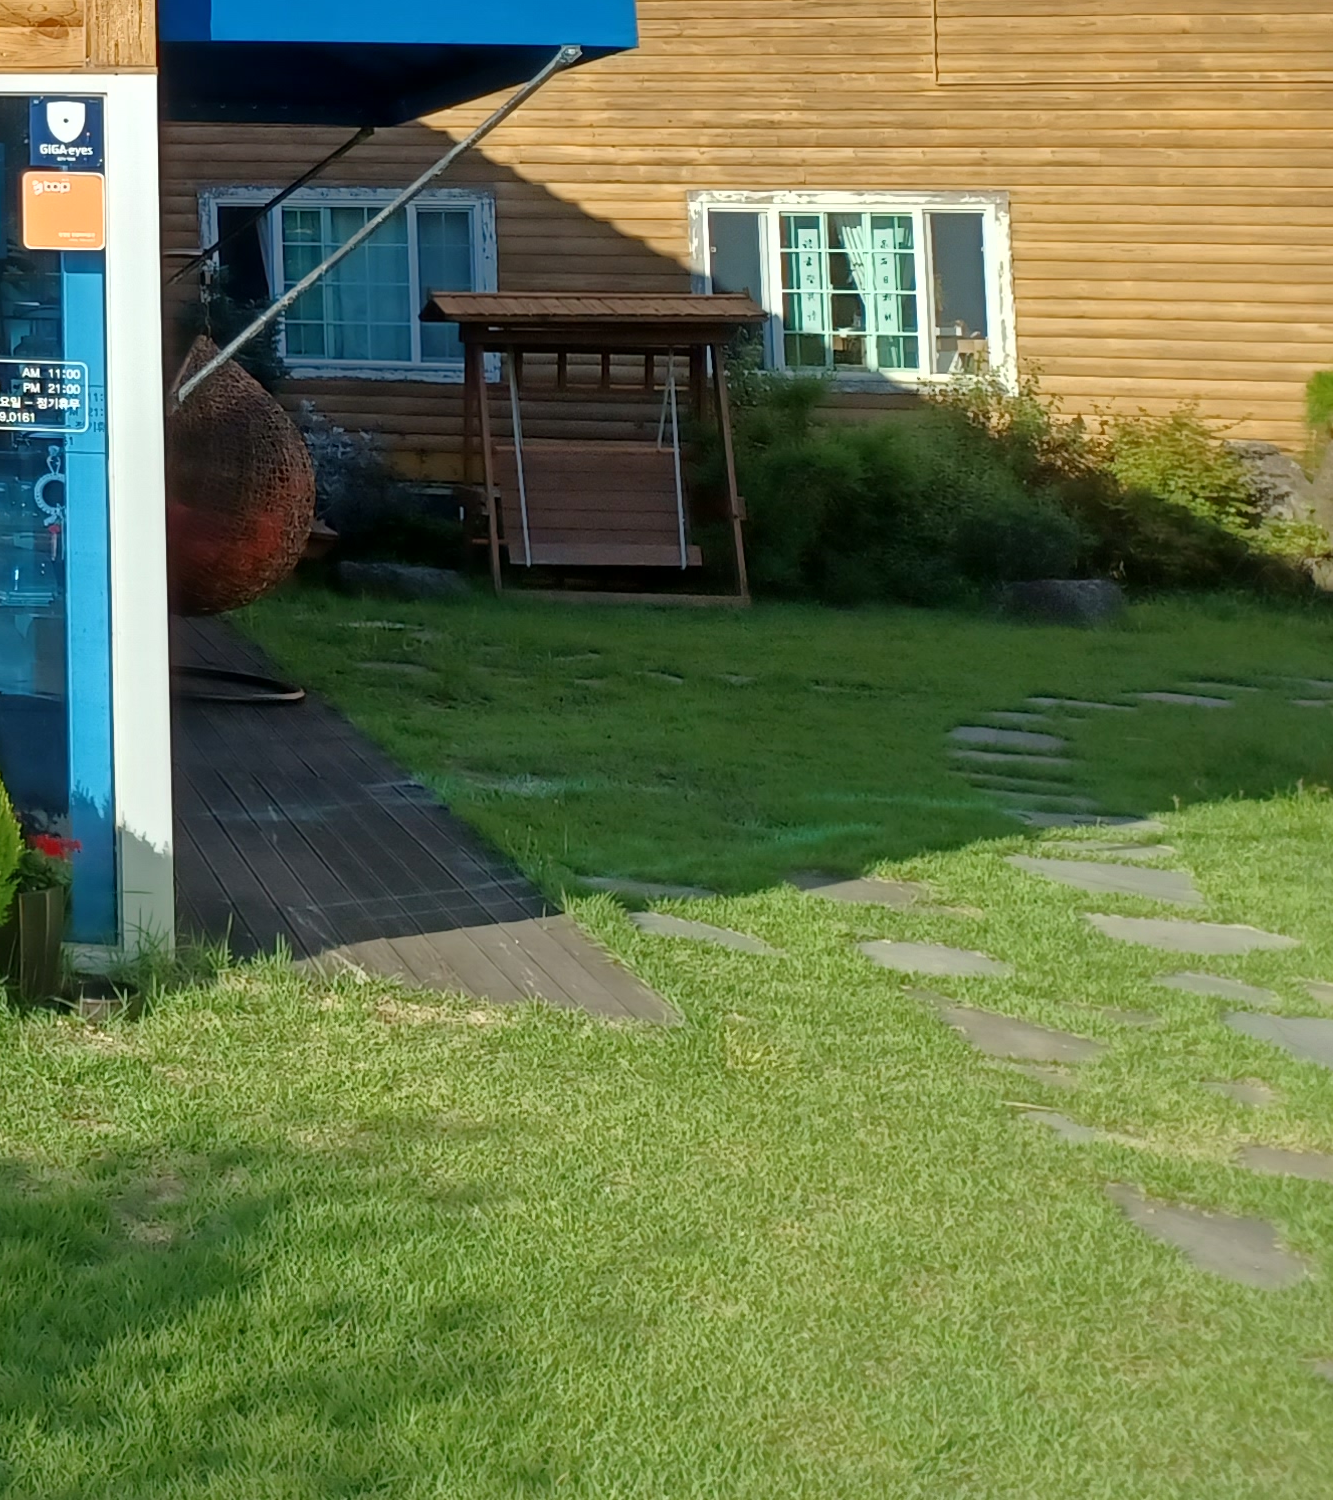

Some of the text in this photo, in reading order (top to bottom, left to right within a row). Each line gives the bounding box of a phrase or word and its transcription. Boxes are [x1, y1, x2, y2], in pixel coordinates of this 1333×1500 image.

[22, 367, 41, 378] AM
[48, 368, 81, 380] 11:00
[23, 383, 41, 394] PM
[47, 384, 81, 395] 21:00
[36, 397, 81, 411] 정기휴무
